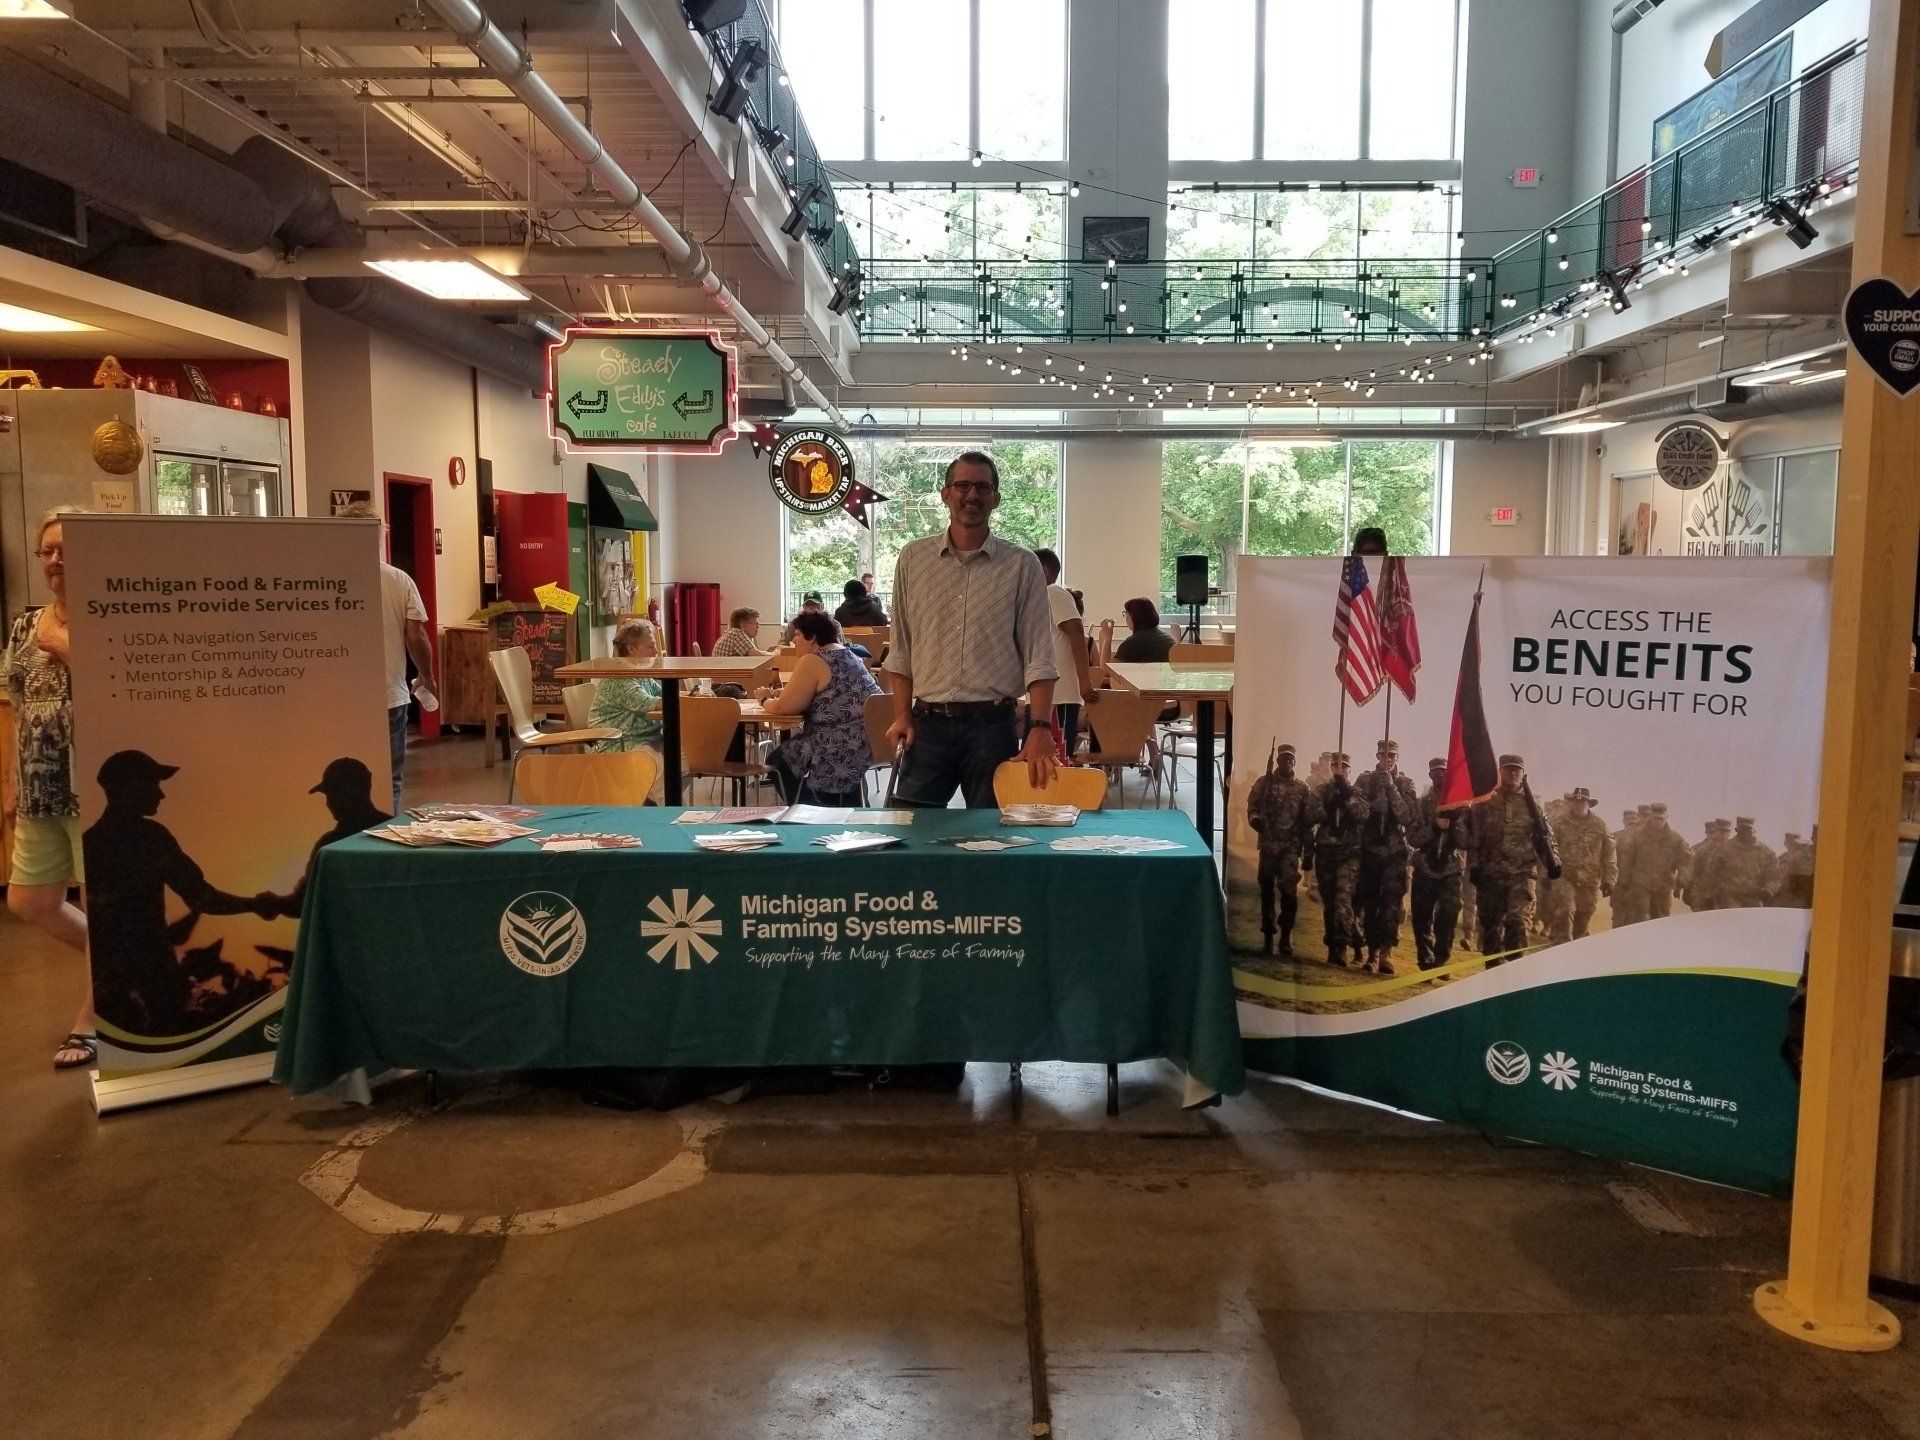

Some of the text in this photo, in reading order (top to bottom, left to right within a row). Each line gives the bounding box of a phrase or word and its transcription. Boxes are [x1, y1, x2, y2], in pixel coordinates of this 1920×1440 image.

[1520, 169, 1537, 182] EXIT
[1864, 323, 1889, 332] YOUR
[1894, 353, 1915, 362] SMALL
[1897, 348, 1915, 356] SHOP
[597, 345, 682, 385] Steady
[614, 383, 666, 414] Eddy's
[626, 413, 658, 436] café
[774, 431, 849, 467] MICHIGAN BEER
[838, 476, 850, 493] TAP
[117, 492, 127, 502] Up
[1496, 508, 1513, 521] EXIT
[528, 542, 543, 550] ENTRY
[106, 577, 348, 595] Michigan Food & Farming
[88, 596, 365, 618] Systems Provide Services for:
[1550, 609, 1712, 633] ACCESS THE
[123, 629, 318, 647] USDA Navigation Services
[124, 645, 350, 665] Veteran Community Outreach
[1512, 637, 1754, 684] BENEFITS
[126, 664, 305, 684] Mentorship & Advocacy
[127, 682, 286, 702] Training & Education
[1510, 683, 1748, 716] YOU FOUGHT FOR
[741, 890, 939, 918] Michigan Food &
[742, 916, 1022, 941] Farming Systems-MIFFS
[503, 934, 585, 975] MIFFS VETS-IN-AG NETWORK
[745, 942, 1025, 969] Supporting the Many Faces of Farming
[1590, 1061, 1693, 1091] Michigan Food &
[1589, 1073, 1737, 1112] Farming Systems-MIFFS
[1590, 1087, 1738, 1127] Supporting the Many Faces of Farming
